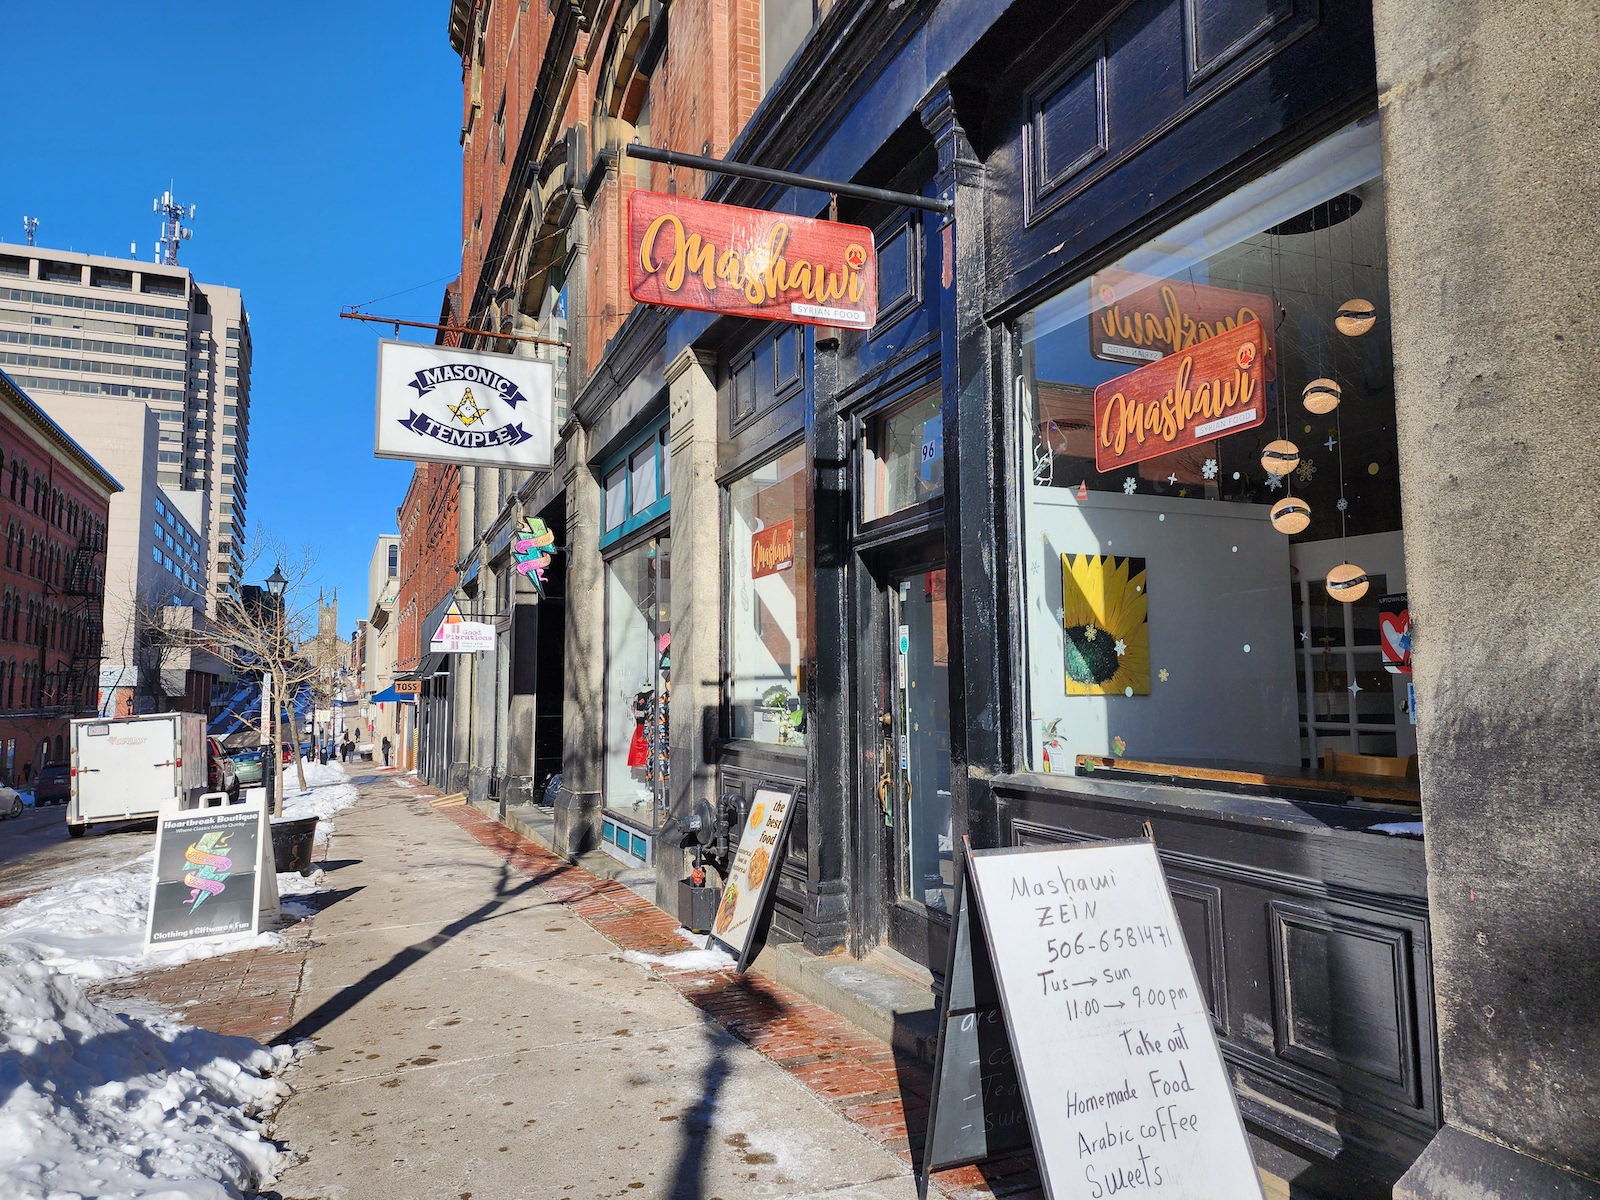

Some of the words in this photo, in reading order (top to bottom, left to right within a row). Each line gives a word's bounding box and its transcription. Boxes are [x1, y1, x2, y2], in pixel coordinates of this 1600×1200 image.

[640, 214, 866, 304] Mashawi
[797, 305, 831, 318] SYRIAN
[833, 309, 860, 320] FOOD
[423, 366, 510, 393] MASONIC
[1101, 343, 1256, 456] Mashawi
[426, 418, 512, 447] TEMPLE
[1200, 420, 1226, 434] SYRIAN
[1228, 412, 1251, 426] FOOD
[922, 442, 934, 461] 96
[396, 683, 418, 691] TOSS
[773, 800, 786, 813] the
[164, 816, 215, 829] Heartbreak
[217, 813, 258, 824] Boutique
[211, 823, 227, 831] Meets
[765, 816, 782, 830] best
[759, 831, 777, 846] food
[153, 929, 188, 940] Clothing
[195, 924, 229, 935] Giftware
[1047, 925, 1172, 963] 506-6581471
[1037, 970, 1069, 995] Tus
[1119, 1028, 1162, 1056] Take
[1168, 1023, 1189, 1052] out
[1067, 1079, 1138, 1118] Homemade
[1149, 1060, 1194, 1097] Food
[1079, 1122, 1134, 1159] Arabic
[1086, 1144, 1162, 1198] Sweets
